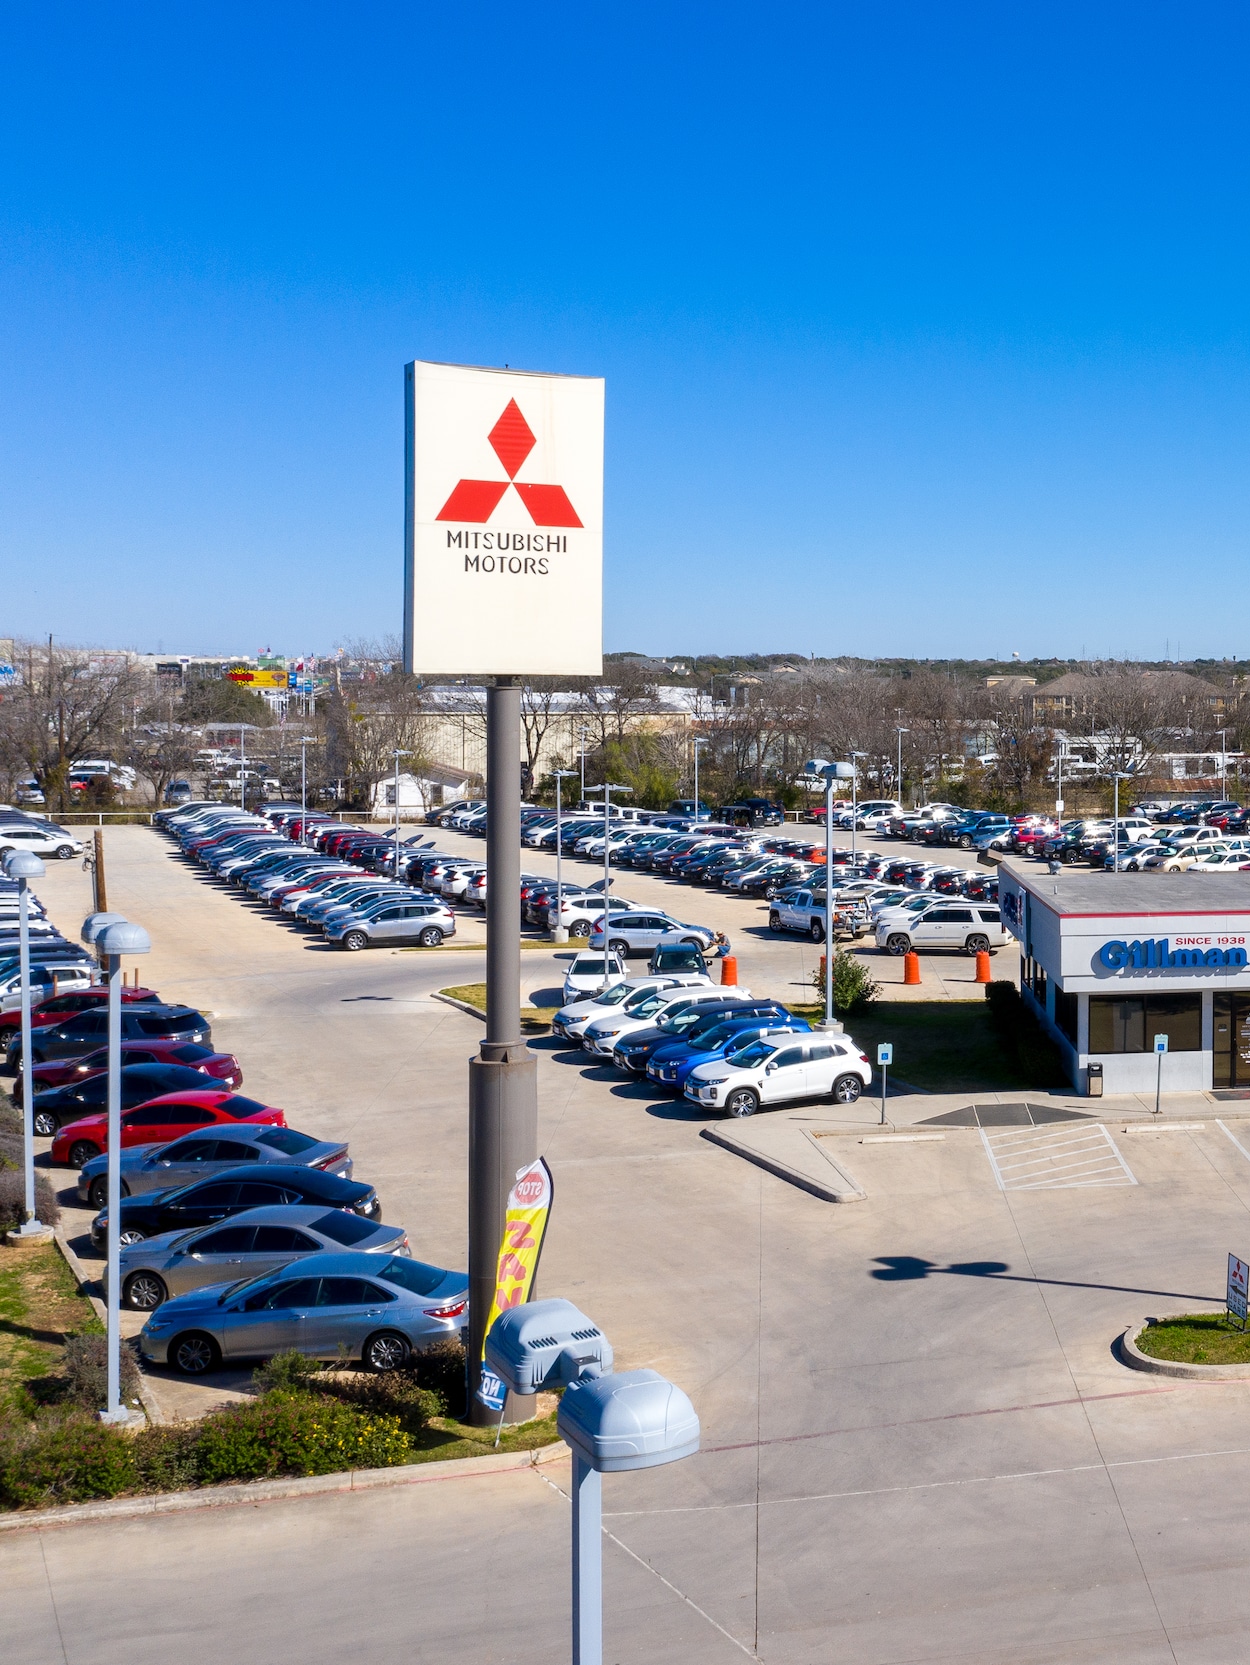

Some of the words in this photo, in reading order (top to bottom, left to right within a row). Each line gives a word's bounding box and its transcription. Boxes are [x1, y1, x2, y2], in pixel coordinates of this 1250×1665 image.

[446, 529, 568, 553] MITSUBISHI
[464, 554, 549, 575] MOTORS
[1175, 937, 1212, 946] SINCE
[1216, 936, 1246, 945] 1938
[1099, 938, 1250, 970] Gillman
[1228, 1292, 1246, 1309] USED
